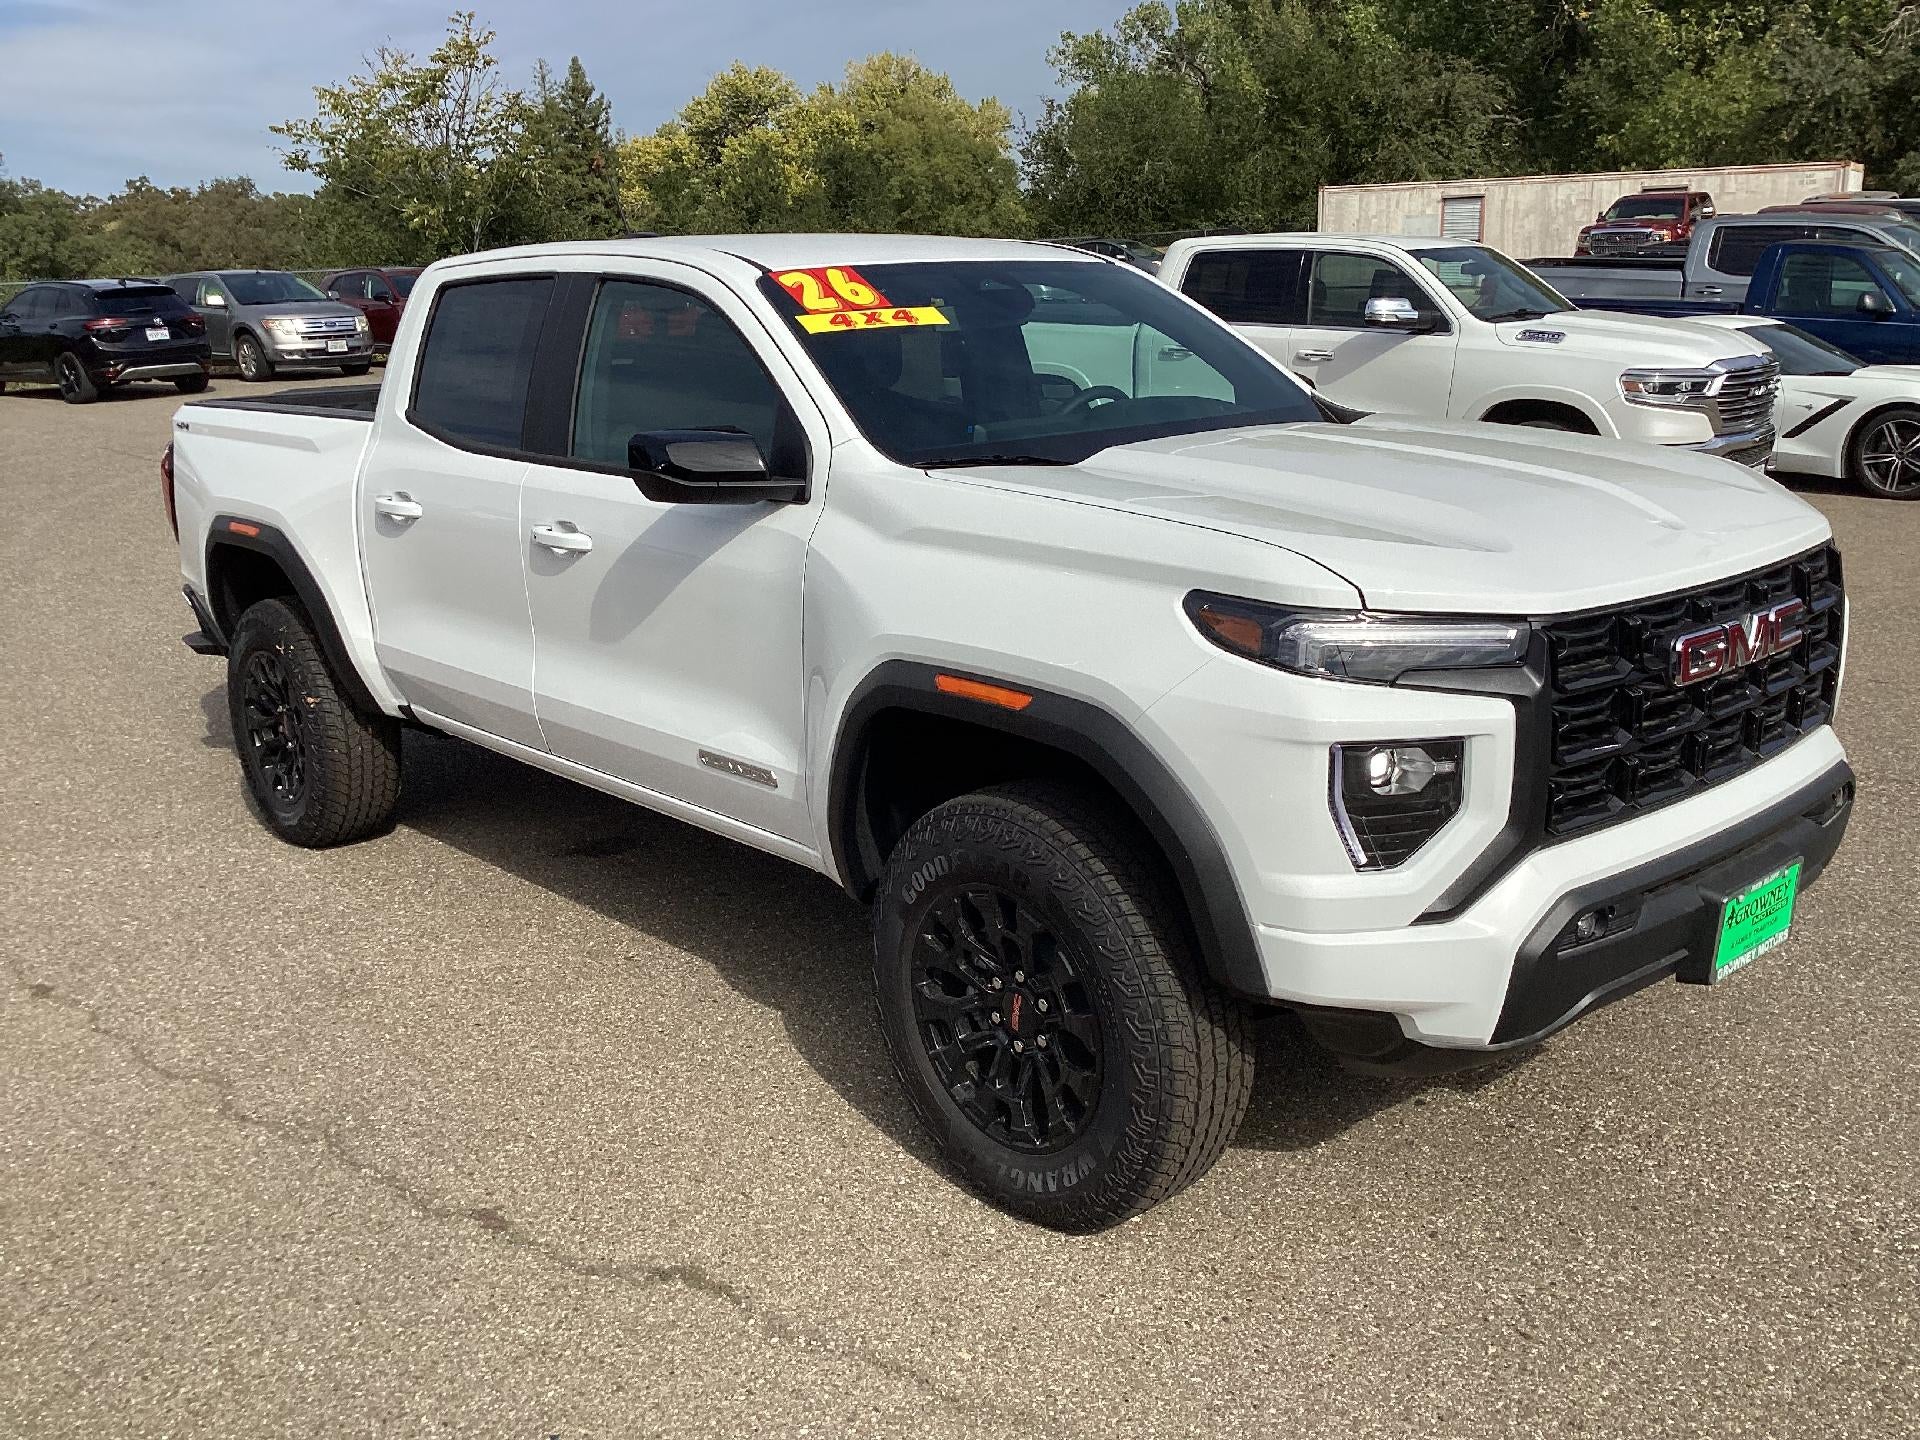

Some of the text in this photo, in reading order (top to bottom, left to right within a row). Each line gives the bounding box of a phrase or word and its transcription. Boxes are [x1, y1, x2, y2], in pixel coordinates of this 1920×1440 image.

[778, 268, 880, 312] 26
[1675, 597, 1805, 687] GMC
[1734, 880, 1791, 925] GROWNEY
[1717, 952, 1757, 980] GROWNEY
[1757, 928, 1789, 957] MOTORS
